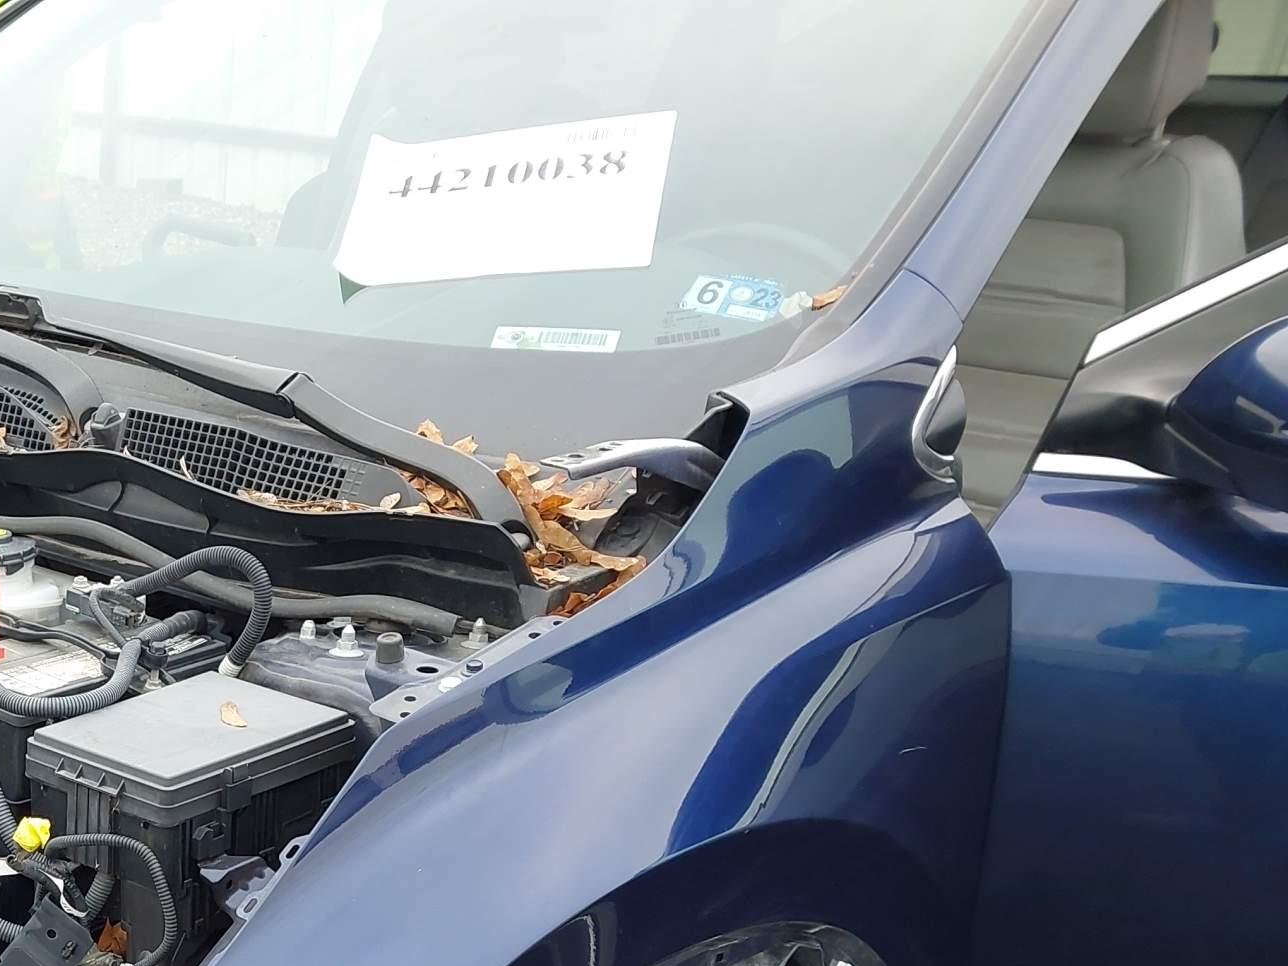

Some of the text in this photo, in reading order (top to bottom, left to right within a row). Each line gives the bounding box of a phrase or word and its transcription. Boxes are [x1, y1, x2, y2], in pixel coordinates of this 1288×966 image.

[388, 150, 627, 198] 44210038
[696, 279, 724, 305] 6
[750, 287, 783, 309] 23
